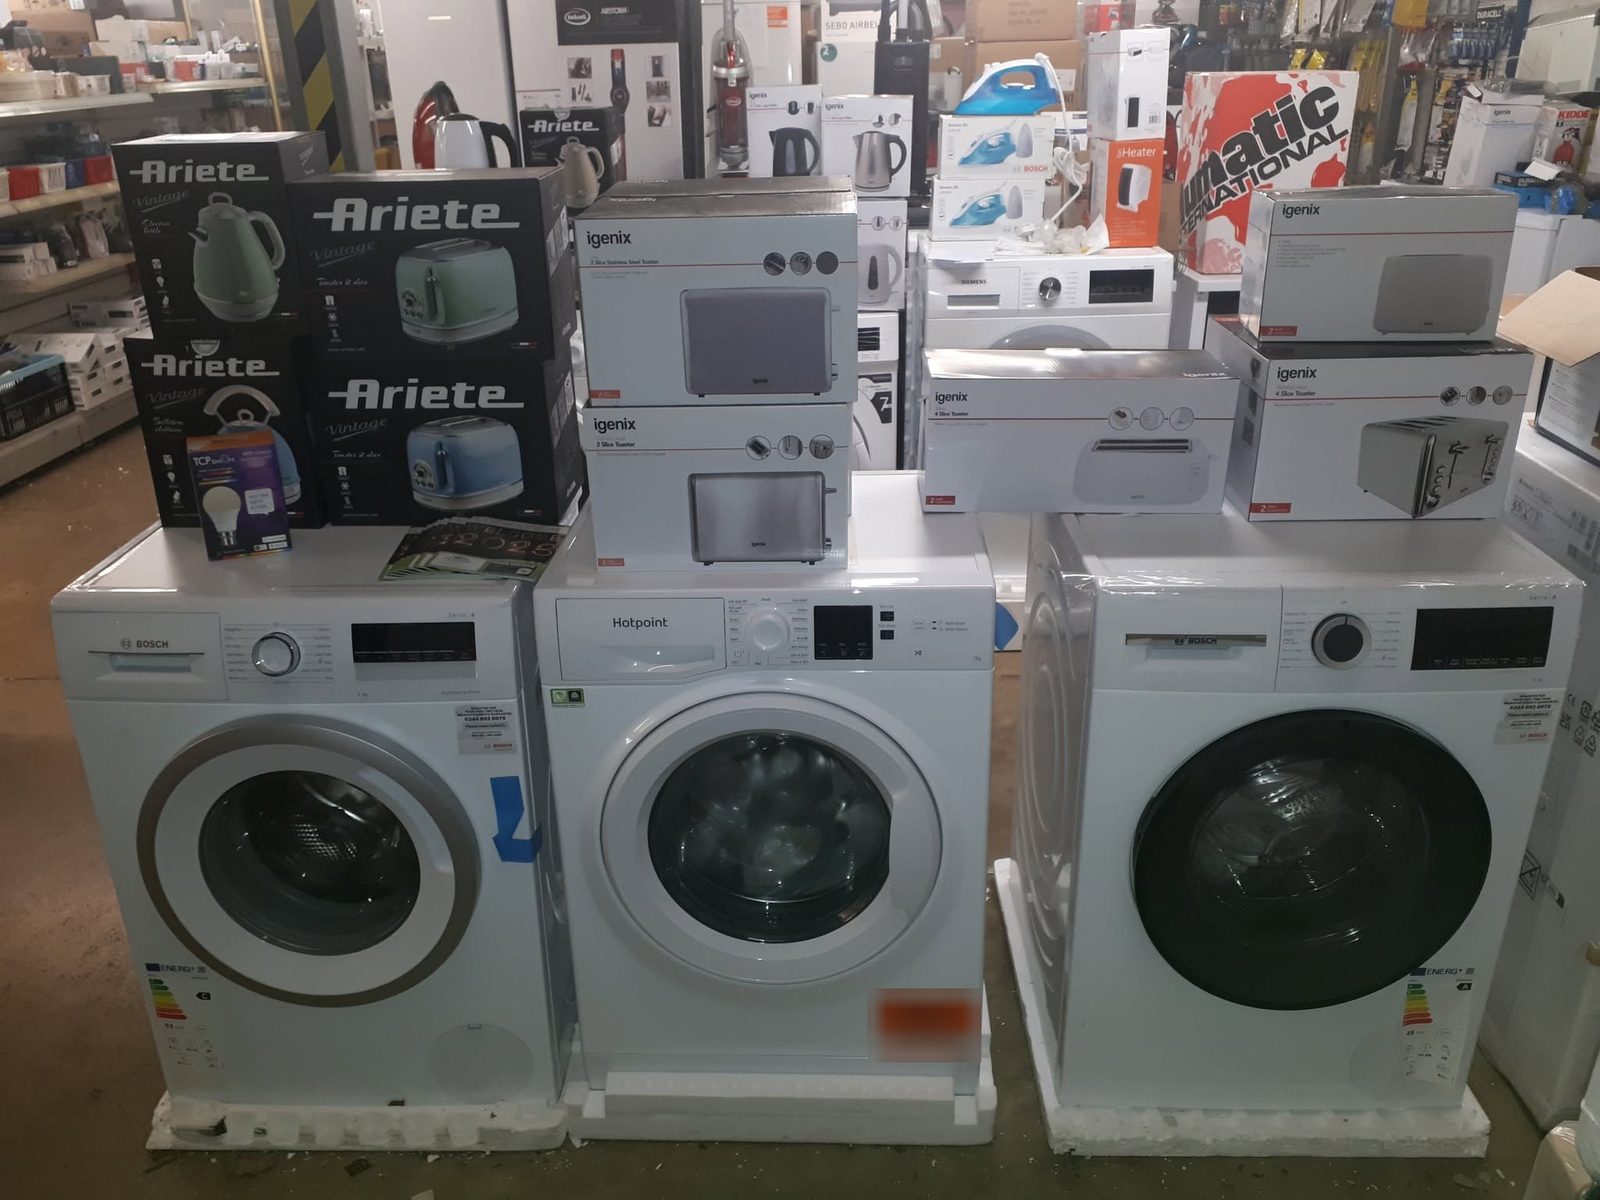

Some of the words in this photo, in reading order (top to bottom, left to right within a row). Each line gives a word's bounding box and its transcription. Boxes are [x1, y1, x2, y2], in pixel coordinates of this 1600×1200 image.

[825, 21, 848, 30] SEBO
[1558, 110, 1590, 119] KIDDE
[527, 119, 600, 133] Ariete
[1181, 86, 1340, 230] umatic
[129, 159, 270, 184] Ariete
[1024, 165, 1048, 173] BOSCH
[313, 196, 521, 232] Ariete
[1282, 204, 1321, 218] igenix
[586, 230, 632, 249] igenix
[308, 239, 376, 261] Vintage
[141, 354, 281, 377] Ariete
[1277, 366, 1317, 383] igenix
[328, 378, 525, 410] Ariete
[936, 391, 969, 405] igenix
[324, 418, 389, 437] Vintage
[593, 417, 637, 434] igenix
[192, 456, 211, 466] TCP
[612, 617, 669, 630] Hotpoint
[136, 640, 169, 649] BOSCH
[1188, 637, 1218, 645] BOSCH
